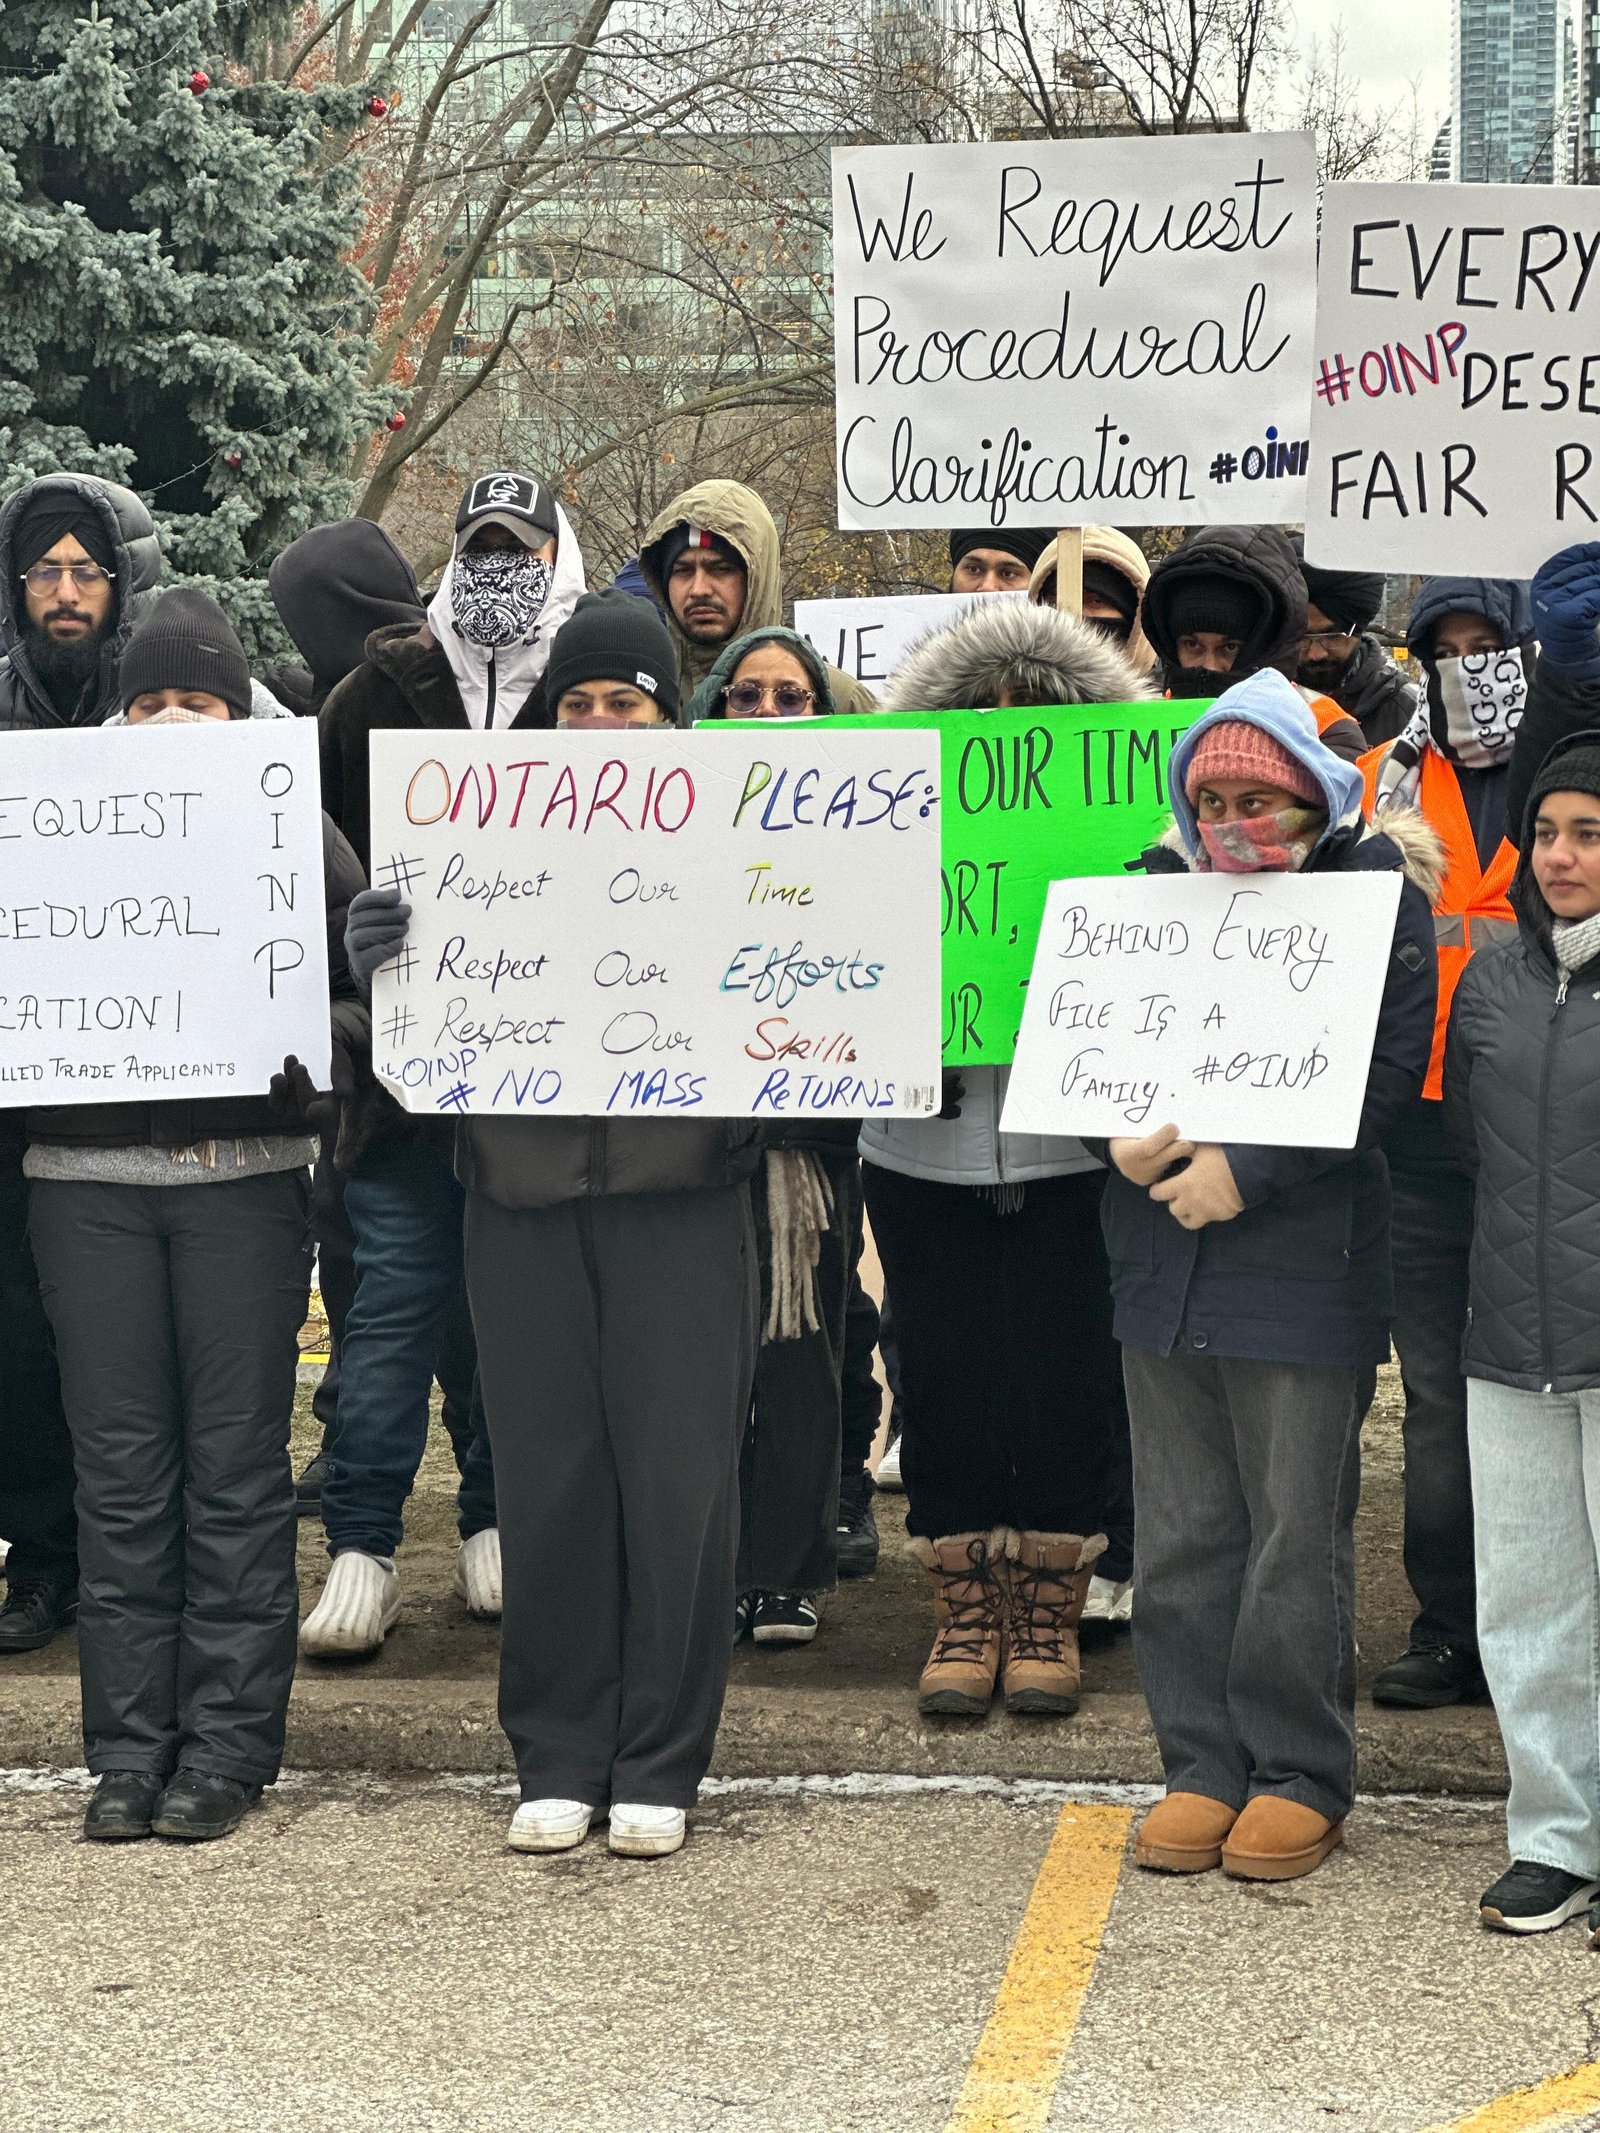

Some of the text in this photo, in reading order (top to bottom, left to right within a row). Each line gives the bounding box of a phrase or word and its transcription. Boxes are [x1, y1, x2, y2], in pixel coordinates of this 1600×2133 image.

[847, 159, 1293, 287] We Request
[1351, 220, 1600, 312] EVERY
[854, 282, 1291, 385] Procedural
[1316, 321, 1468, 407] #OINP
[842, 414, 1196, 527] Clarification
[1331, 444, 1489, 519] FAIR
[405, 758, 696, 834] ONTARIO
[958, 726, 1054, 814] OUR
[608, 868, 680, 905] Our
[744, 862, 815, 906] Time
[594, 950, 669, 987] Our
[719, 940, 885, 1010] Efforts
[1058, 890, 1334, 992] BEHIND EVERY
[602, 1011, 693, 1055] Our
[744, 1016, 858, 1065] Skills
[1203, 1002, 1226, 1030] A
[48, 1057, 116, 1080] TRADE
[123, 1054, 236, 1082] APPLICANTS
[492, 1067, 562, 1107] NO
[606, 1068, 707, 1112] MASS
[1192, 1042, 1329, 1090] #OINP
